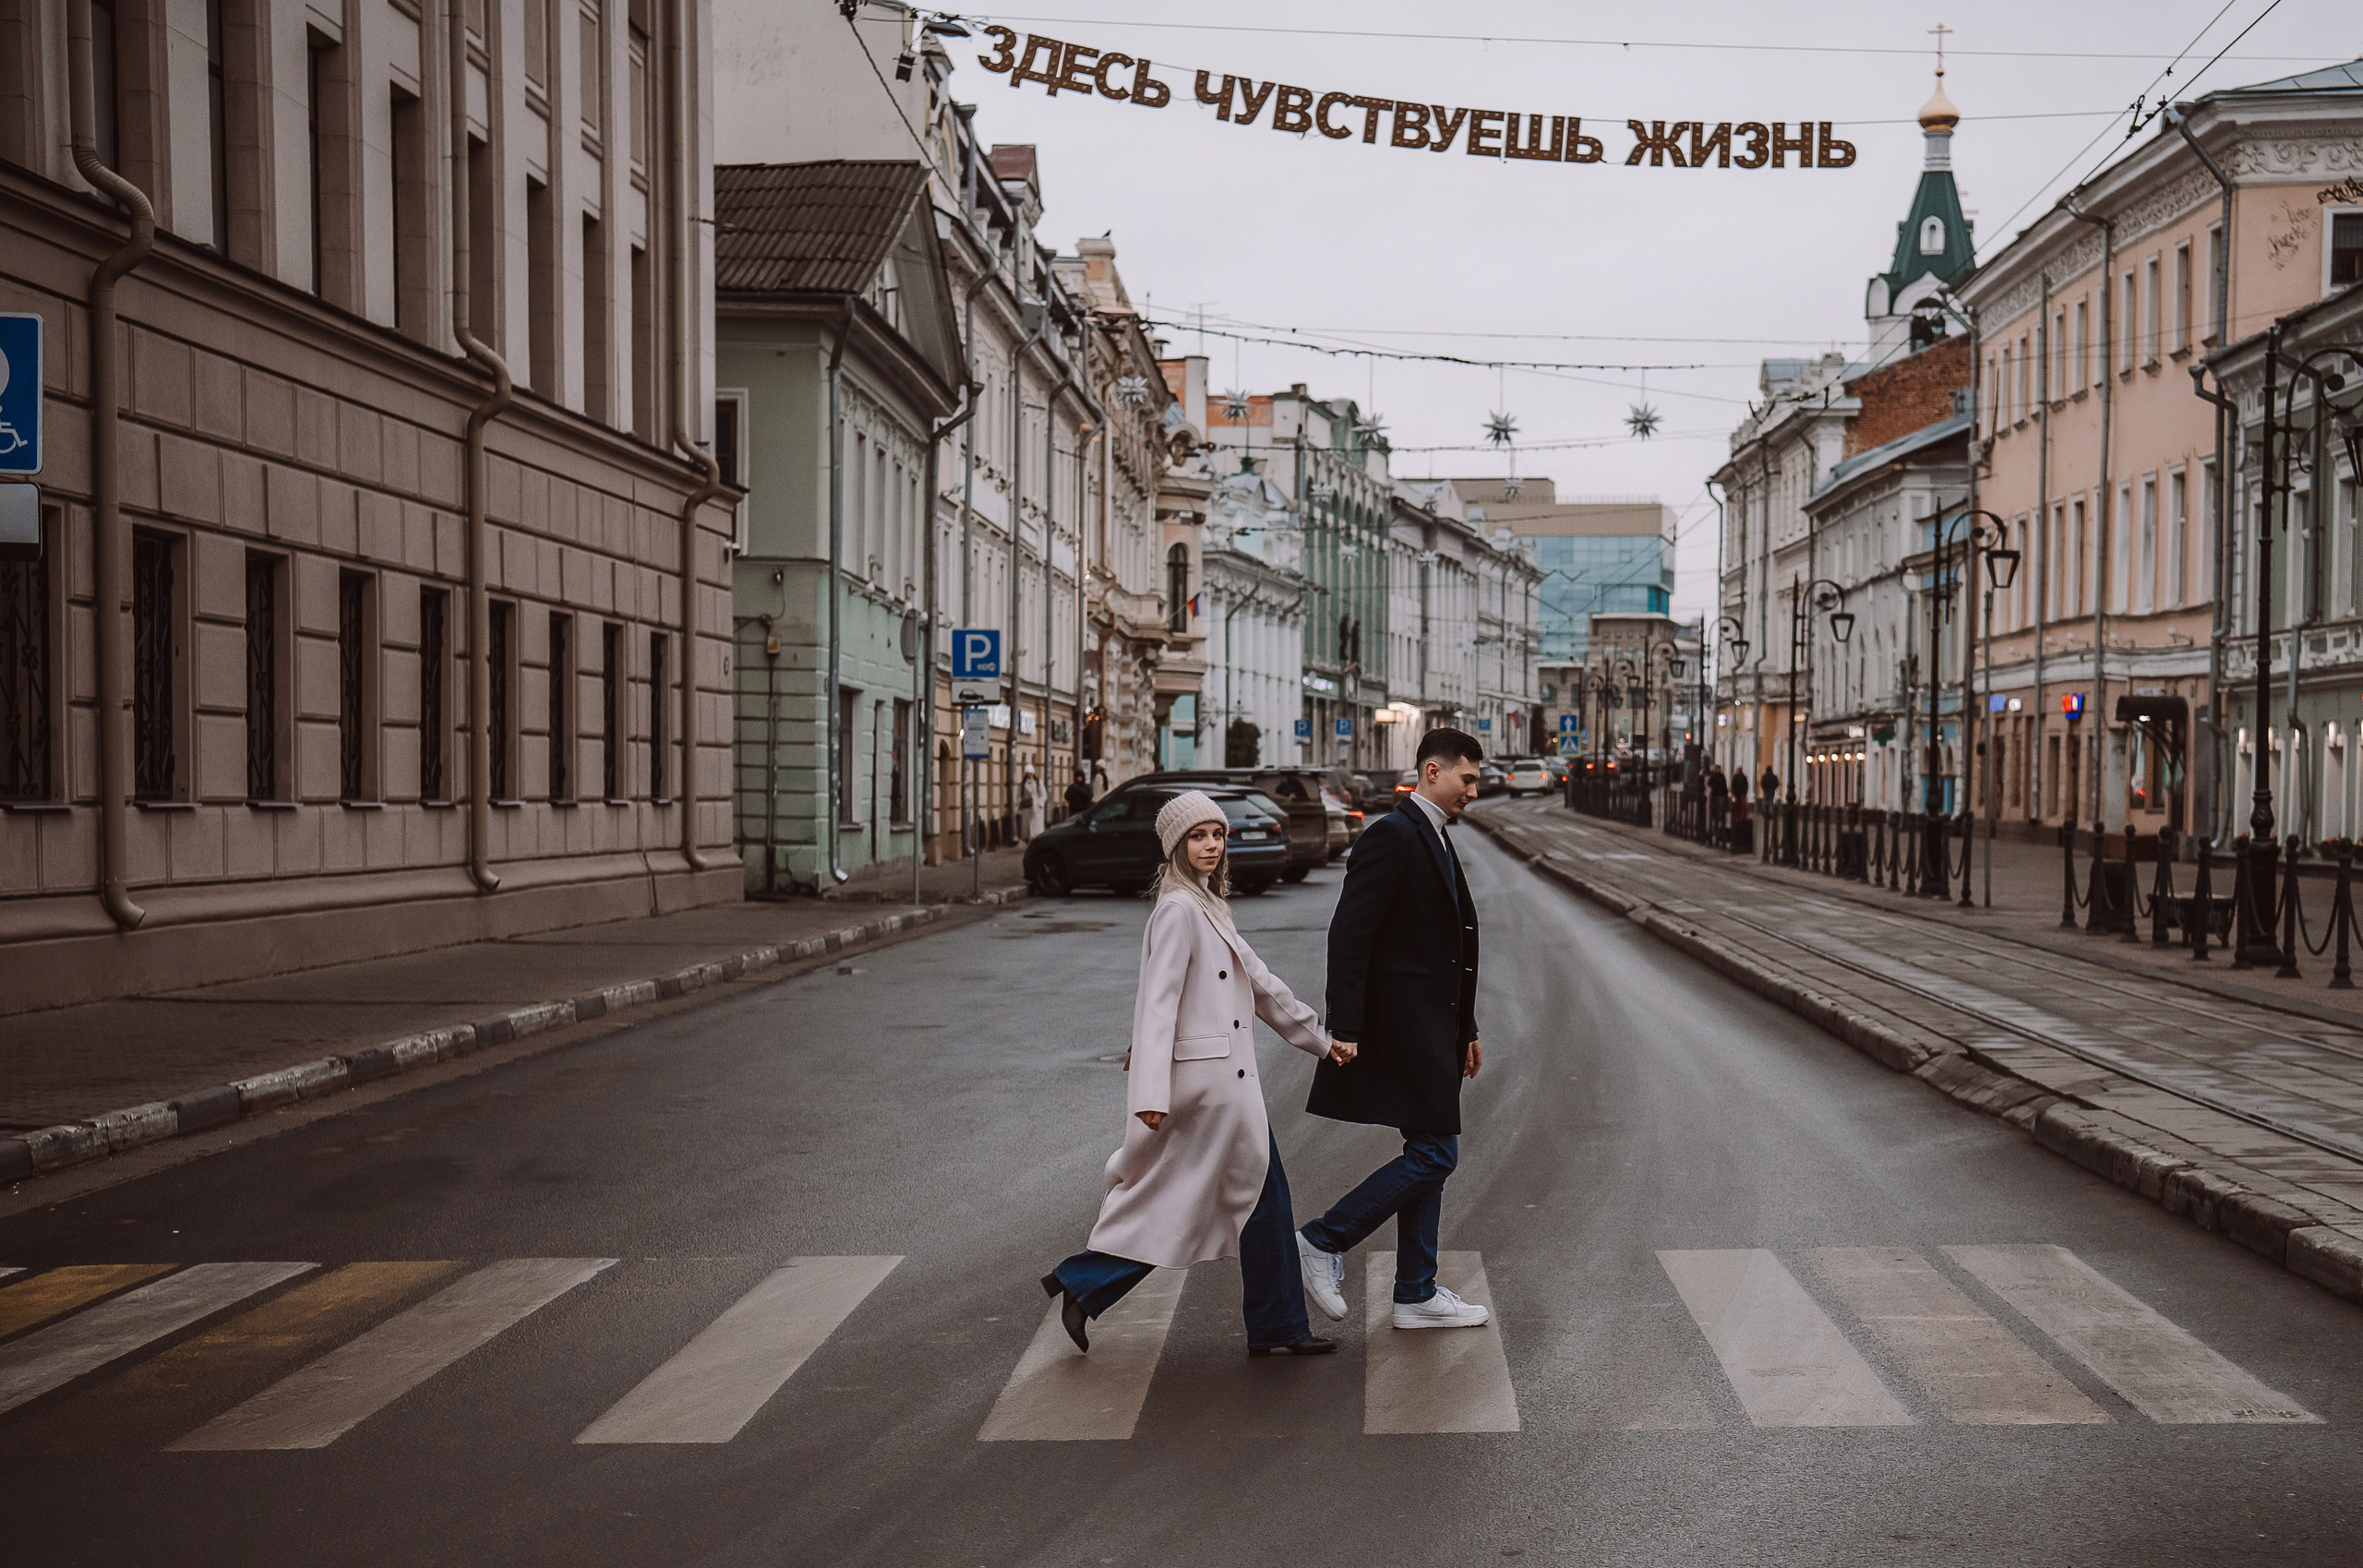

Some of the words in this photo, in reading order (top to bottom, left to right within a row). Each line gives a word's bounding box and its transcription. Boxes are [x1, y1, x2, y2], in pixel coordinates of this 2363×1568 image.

[978, 25, 1171, 108] ЗДЕСЬ
[1194, 69, 1607, 164] ЧУВСТВУЕШЬ
[1625, 119, 1857, 170] ЖИЗНЬ
[965, 634, 992, 673] P
